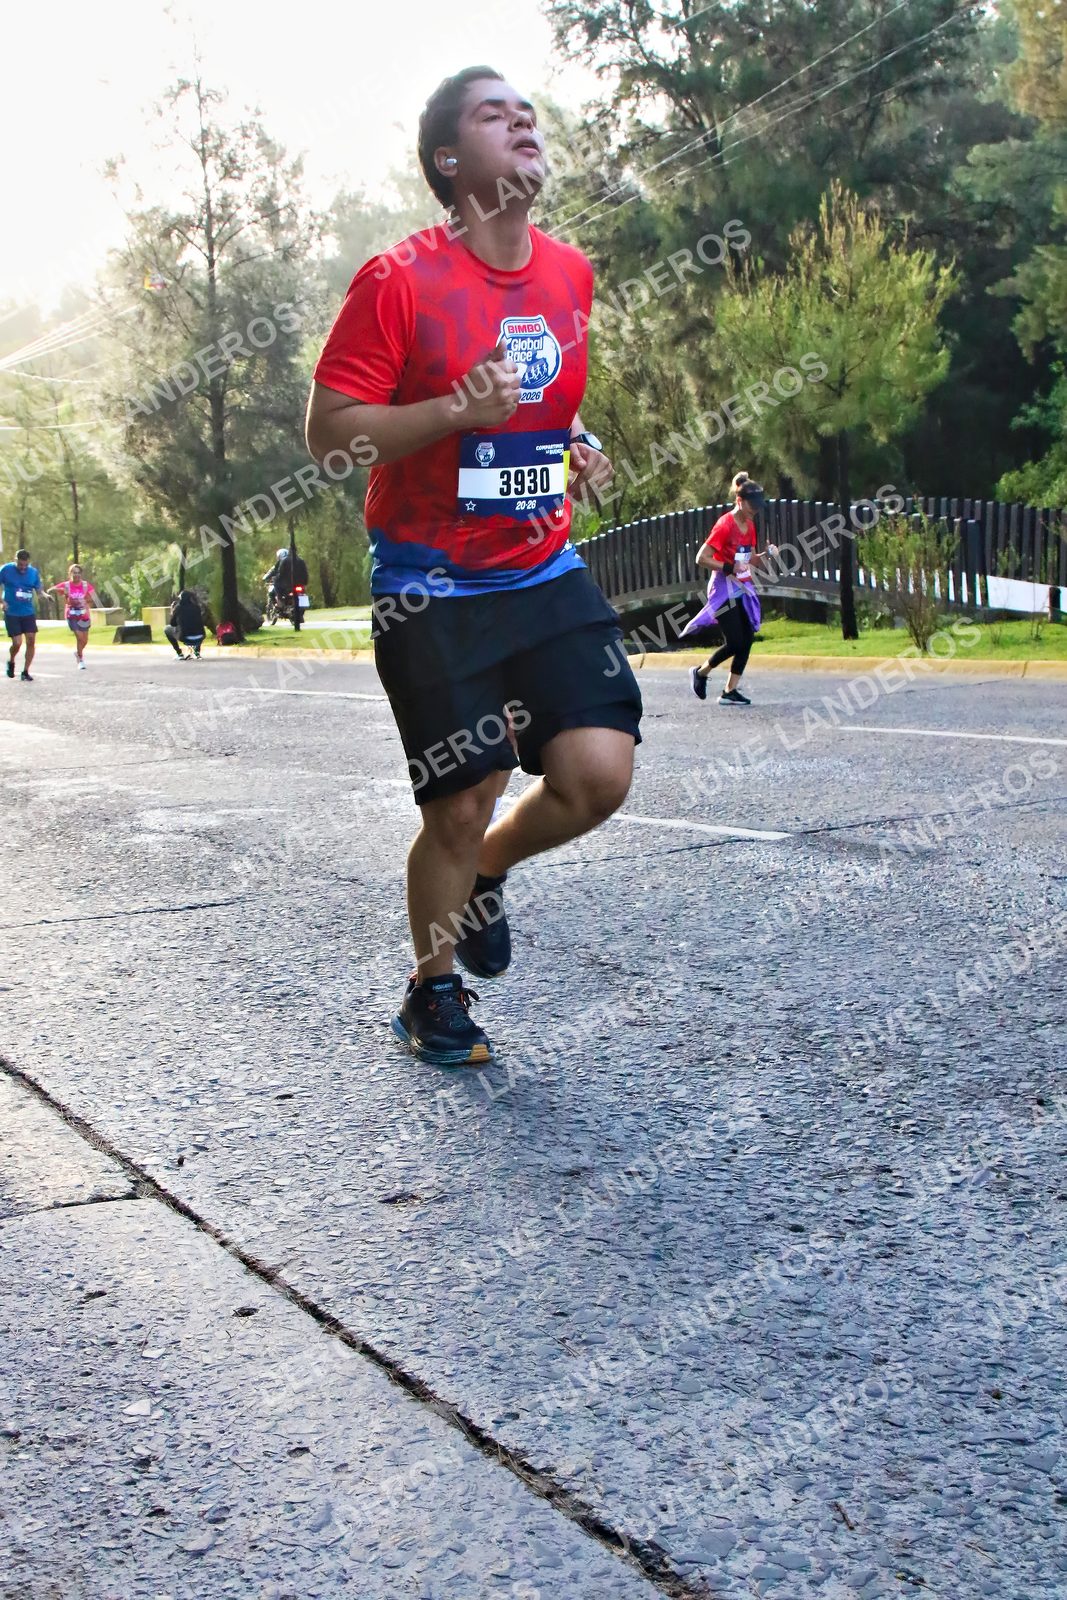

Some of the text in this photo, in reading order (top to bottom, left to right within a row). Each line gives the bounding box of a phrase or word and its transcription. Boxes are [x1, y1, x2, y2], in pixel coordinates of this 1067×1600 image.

[508, 323, 542, 334] BIMBO
[511, 337, 543, 350] Global
[506, 350, 532, 362] Race
[521, 392, 541, 401] 2026
[499, 467, 550, 496] 3930
